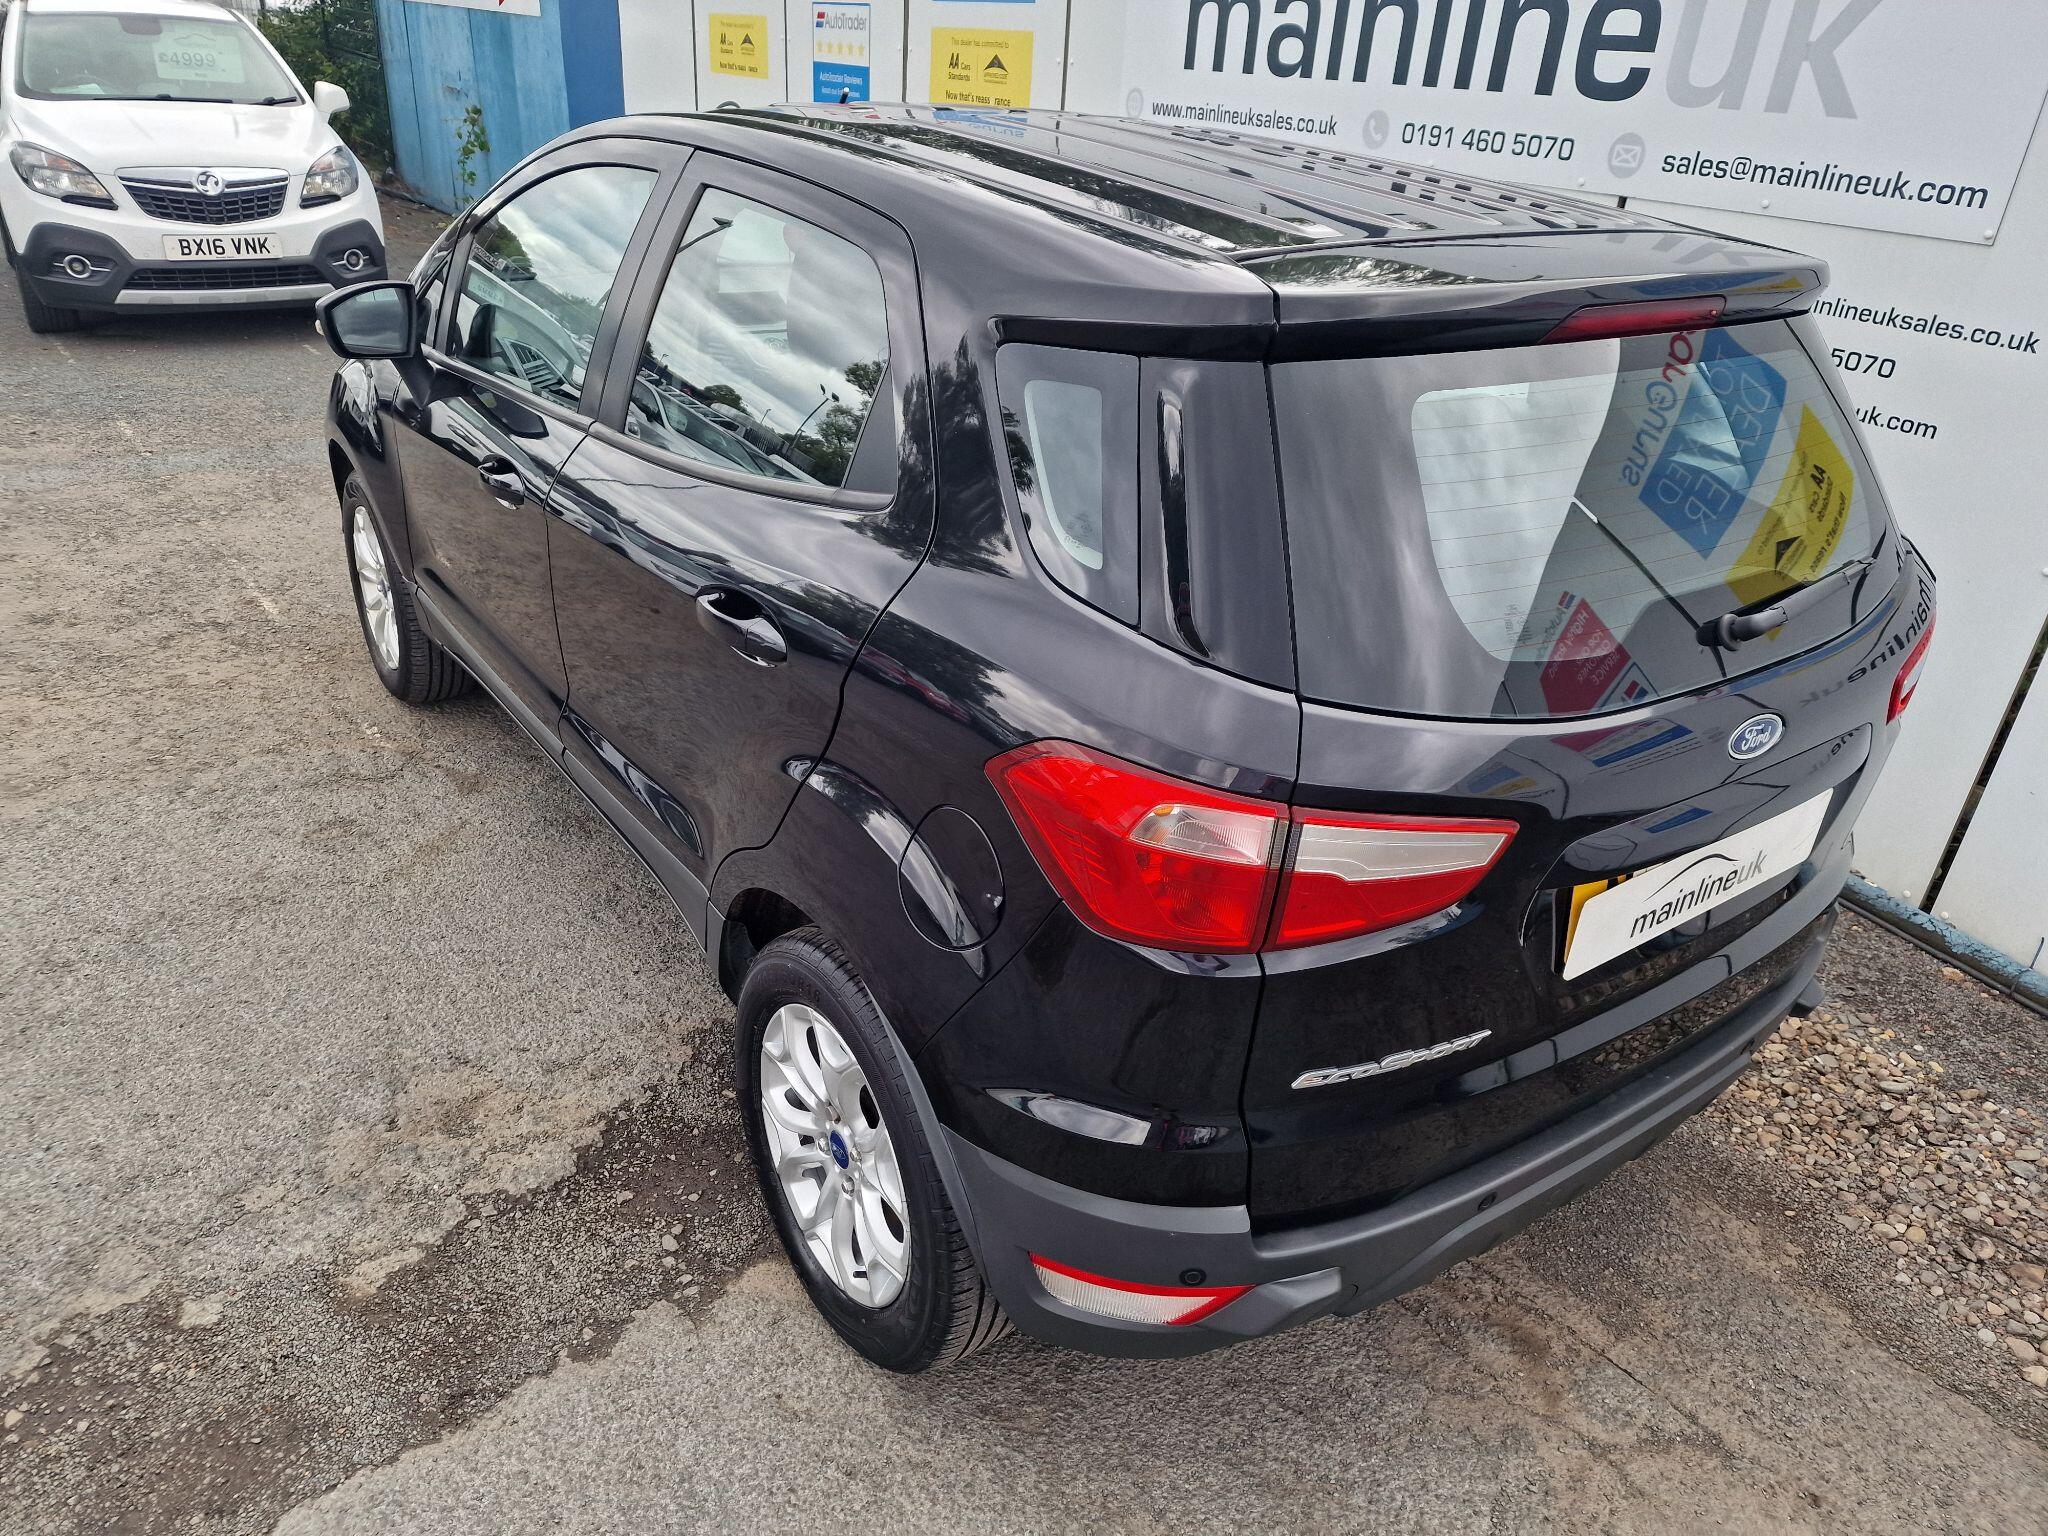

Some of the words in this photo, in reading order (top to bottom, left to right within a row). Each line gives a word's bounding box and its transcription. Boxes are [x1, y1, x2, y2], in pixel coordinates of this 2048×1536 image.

[825, 11, 867, 31] AutoTrader
[948, 52, 960, 69] AA
[945, 89, 958, 100] Now
[1151, 101, 1338, 136] www.mainlineuksales.co.uk
[1401, 122, 1454, 148] 0191
[1461, 128, 1506, 154] 460
[1511, 132, 1575, 161] 5070
[1661, 151, 1990, 209] sales@mainlineuk.com
[178, 238, 226, 256] BX16
[231, 237, 272, 255] VNK
[1831, 347, 1897, 379] 5070
[1741, 723, 1772, 751] Ford
[1629, 849, 1768, 939] mainlineuk
